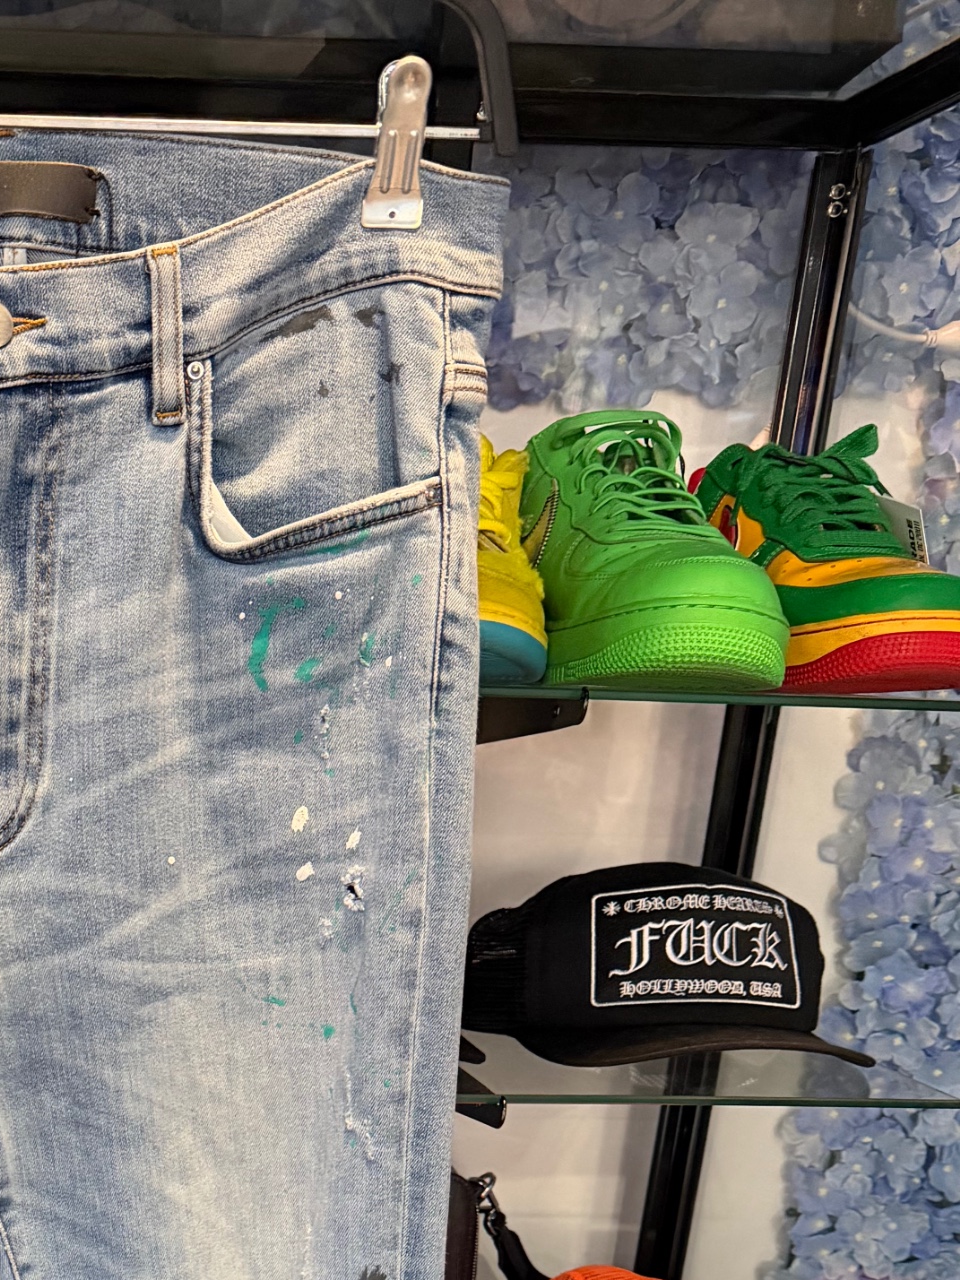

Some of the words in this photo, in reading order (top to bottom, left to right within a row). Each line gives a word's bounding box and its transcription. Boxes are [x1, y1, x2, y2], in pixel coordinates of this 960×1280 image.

[624, 894, 711, 914] CHROME
[713, 895, 774, 914] HEARTS
[749, 981, 783, 998] USA
